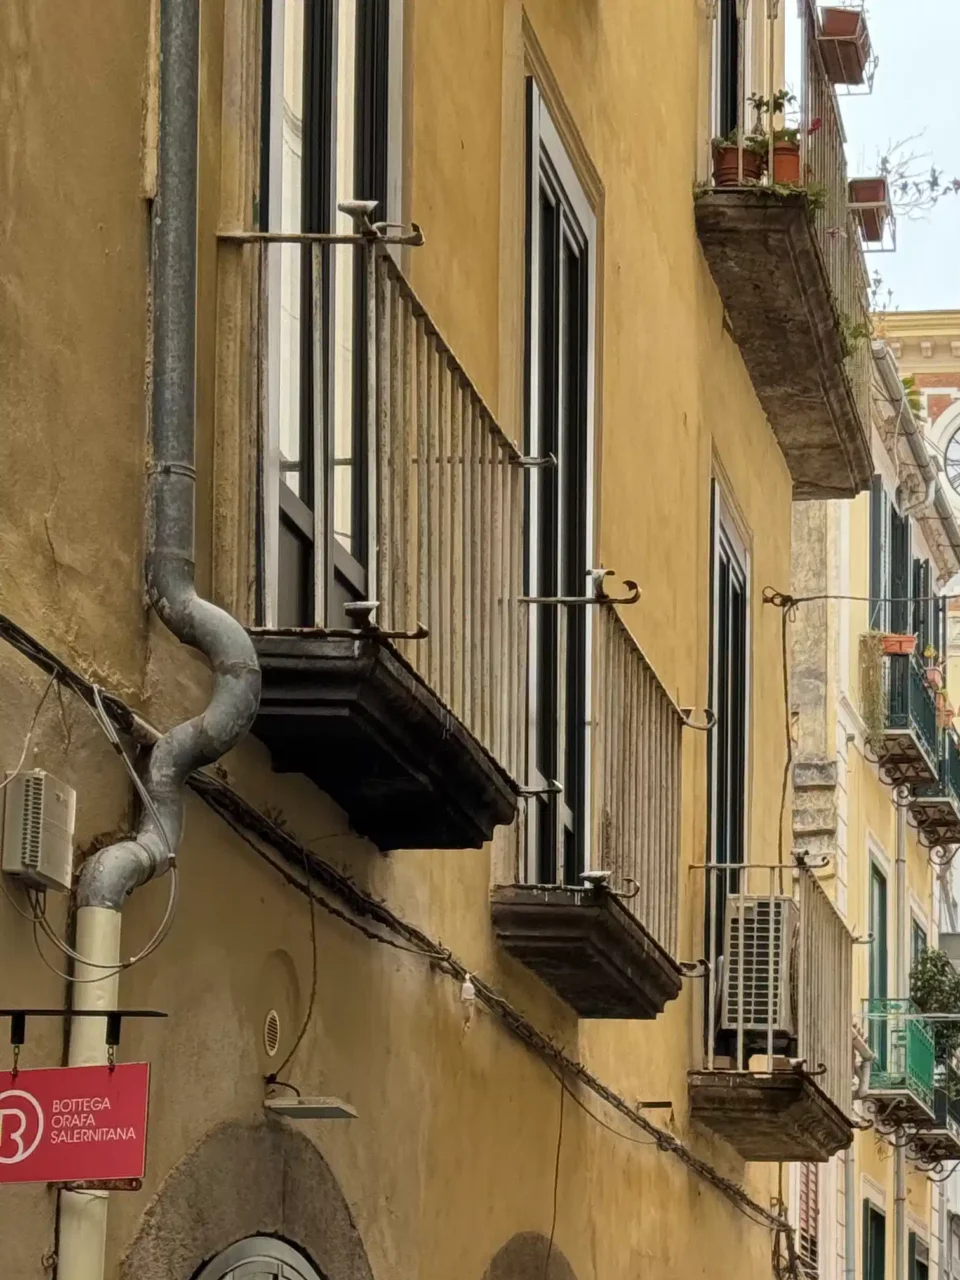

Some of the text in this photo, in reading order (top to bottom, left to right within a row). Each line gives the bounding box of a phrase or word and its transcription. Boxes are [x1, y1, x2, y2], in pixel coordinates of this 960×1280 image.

[52, 1097, 111, 1113] BOTTEGA
[51, 1114, 96, 1129] ORAFA
[50, 1127, 137, 1144] SALERNITANA
